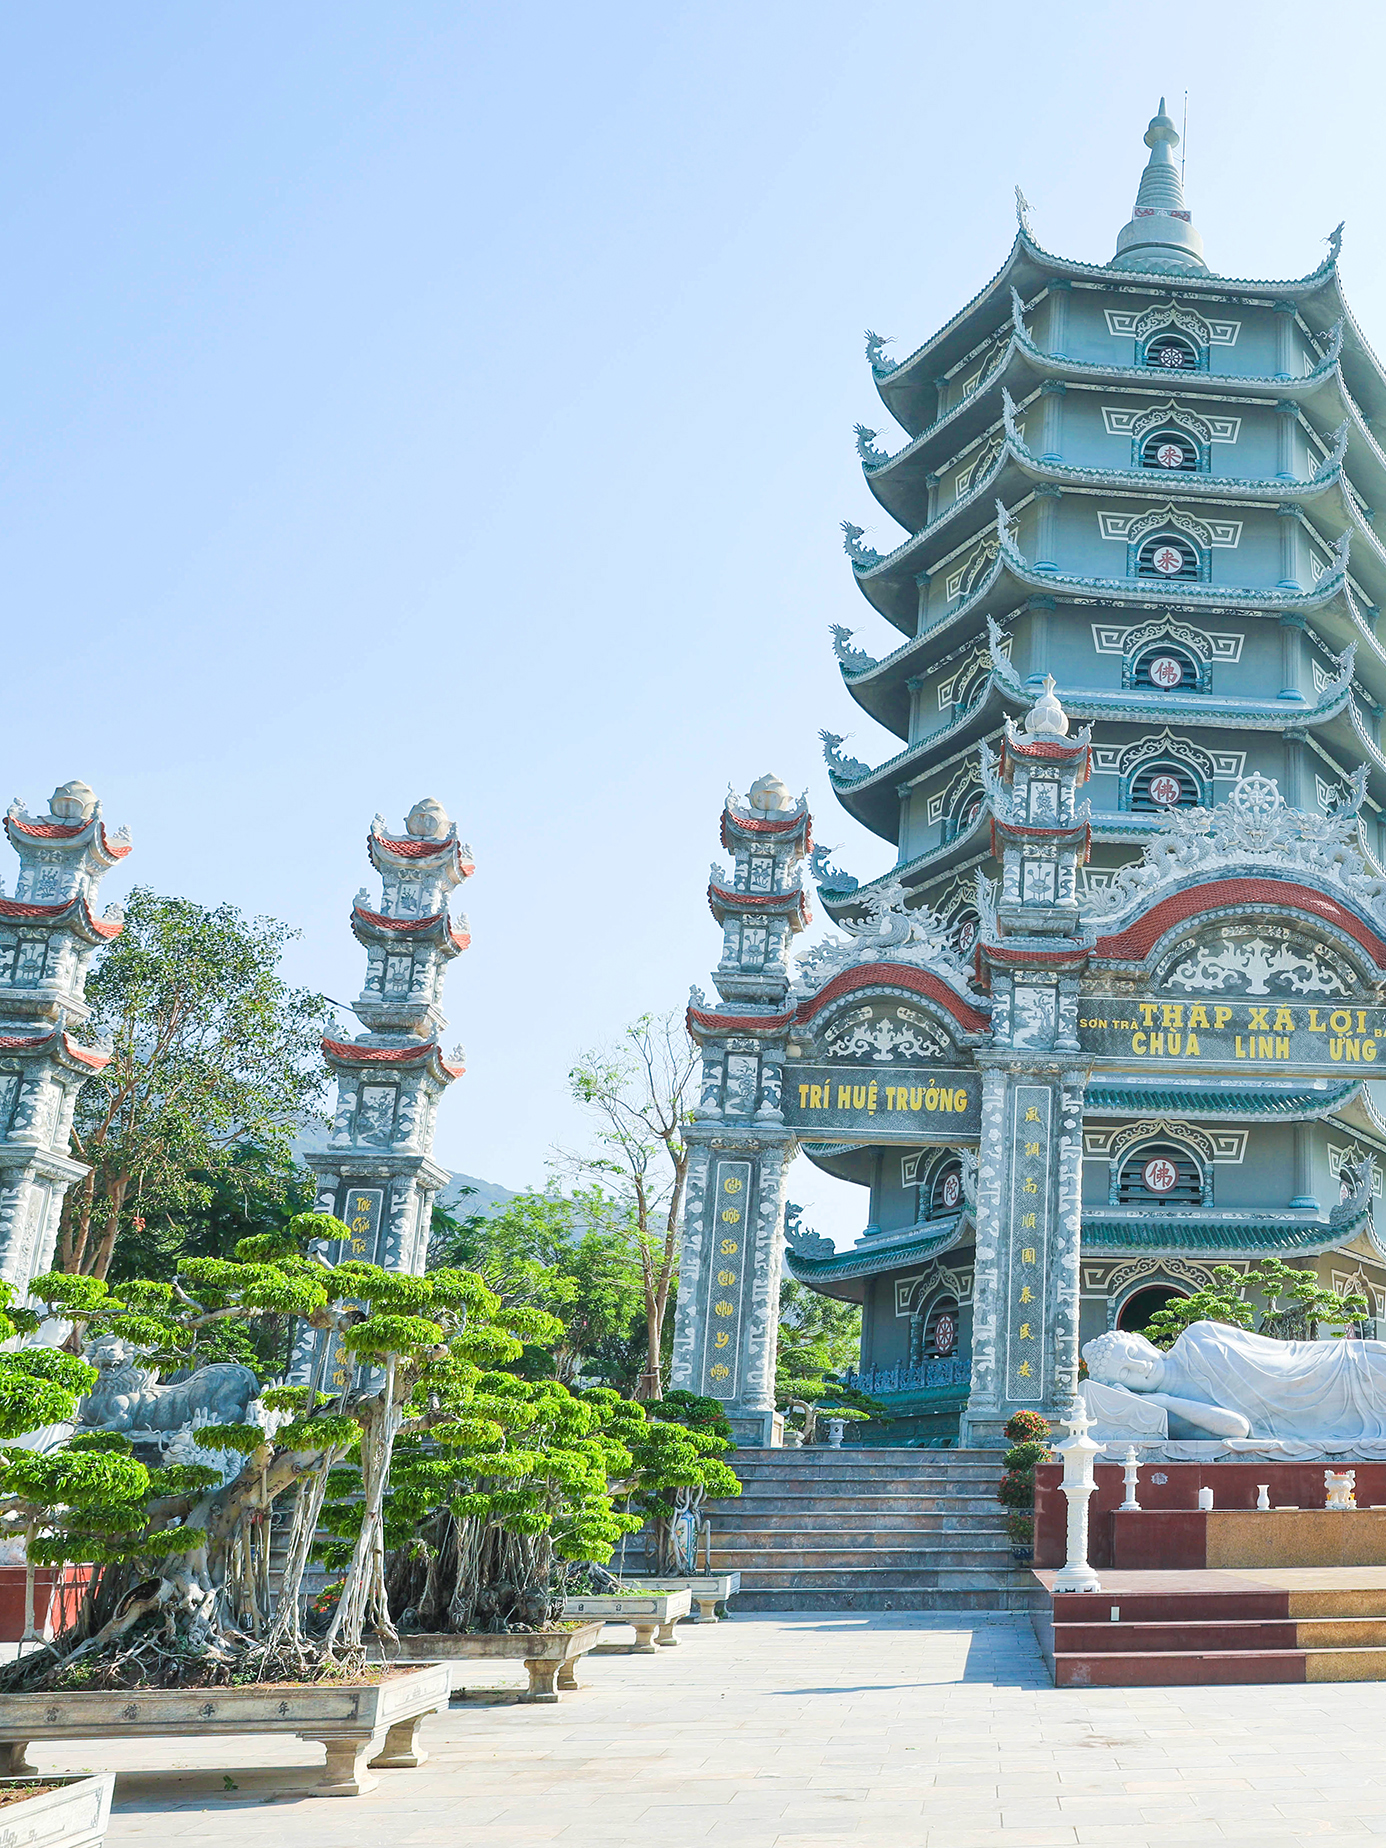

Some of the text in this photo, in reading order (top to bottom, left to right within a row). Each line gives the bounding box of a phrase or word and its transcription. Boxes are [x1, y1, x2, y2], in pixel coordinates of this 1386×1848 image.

[1079, 1017, 1139, 1030] SƠN TRÀ
[1139, 1000, 1367, 1036] THÁP XÁ LỢI
[1131, 1026, 1377, 1062] CHÙA LINH ỨNG
[798, 1078, 968, 1115] TRÍ HUỆ TRƯỞNG
[1148, 1161, 1173, 1188] 佛
